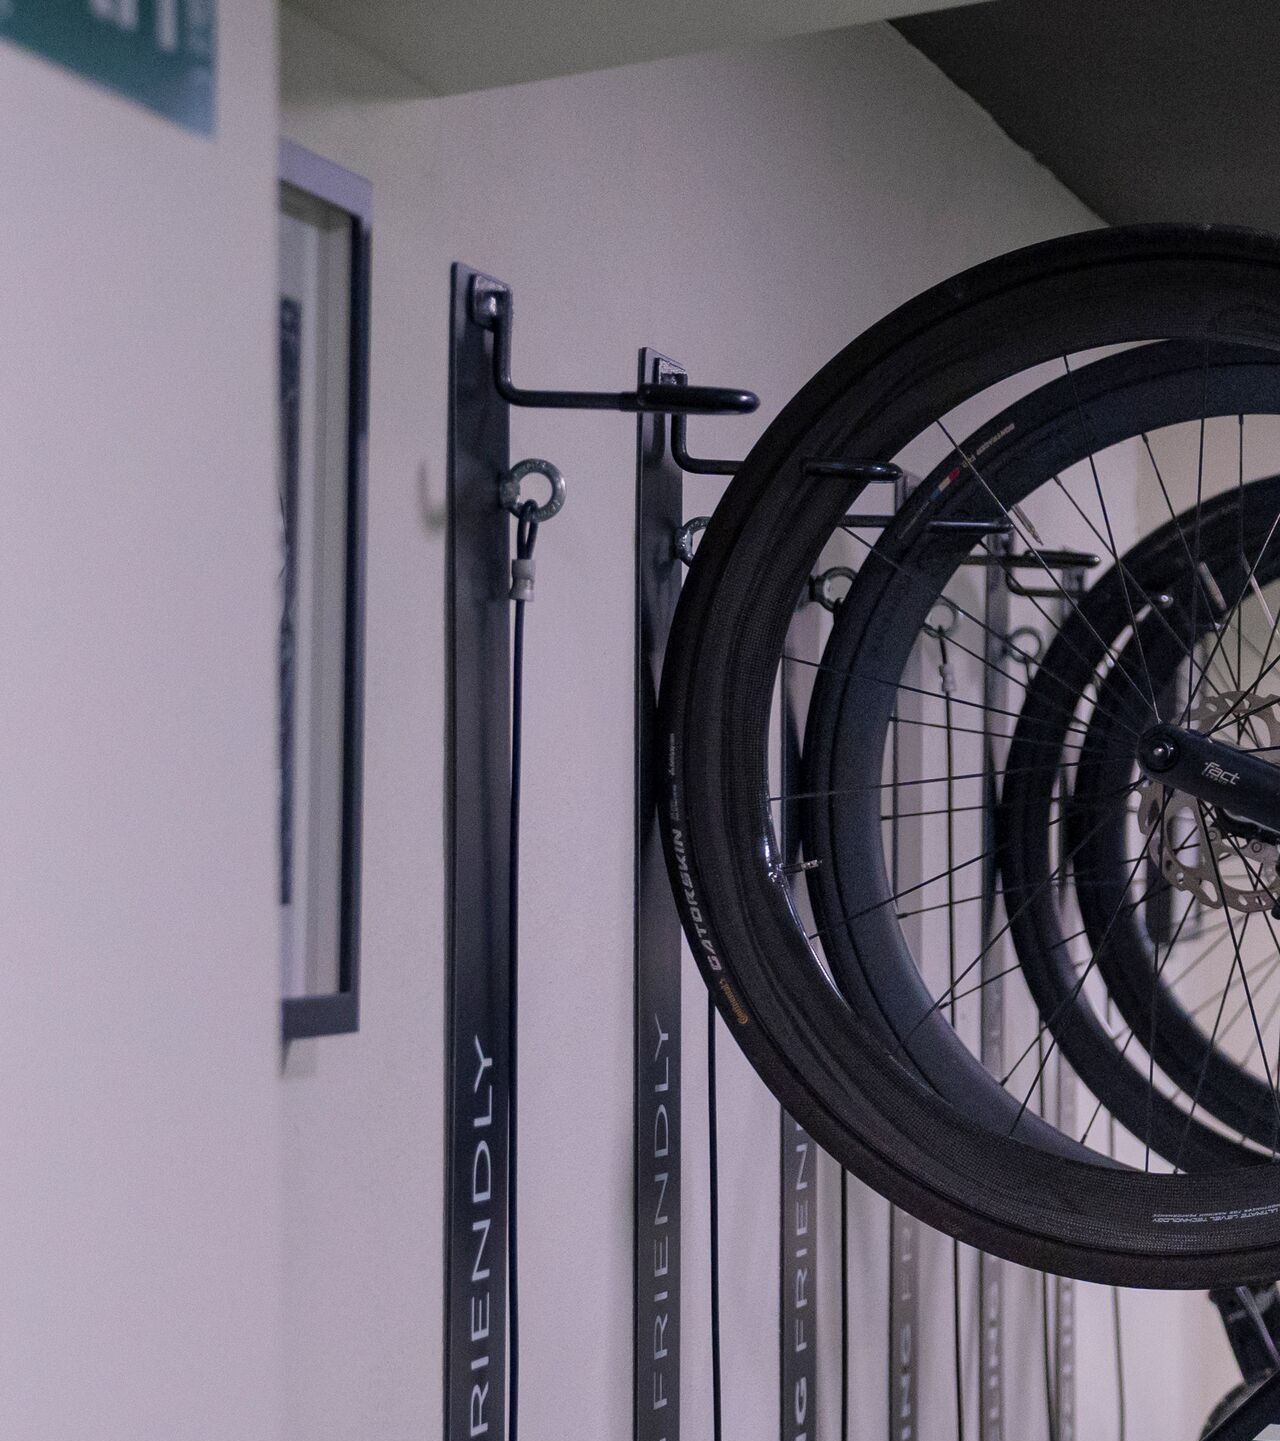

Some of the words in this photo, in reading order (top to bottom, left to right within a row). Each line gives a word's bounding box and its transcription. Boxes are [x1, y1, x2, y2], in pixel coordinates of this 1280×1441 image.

[671, 828, 722, 971] GATORSKIN
[652, 1012, 672, 1411] FRIENDLY
[794, 1123, 809, 1353] FRIEN
